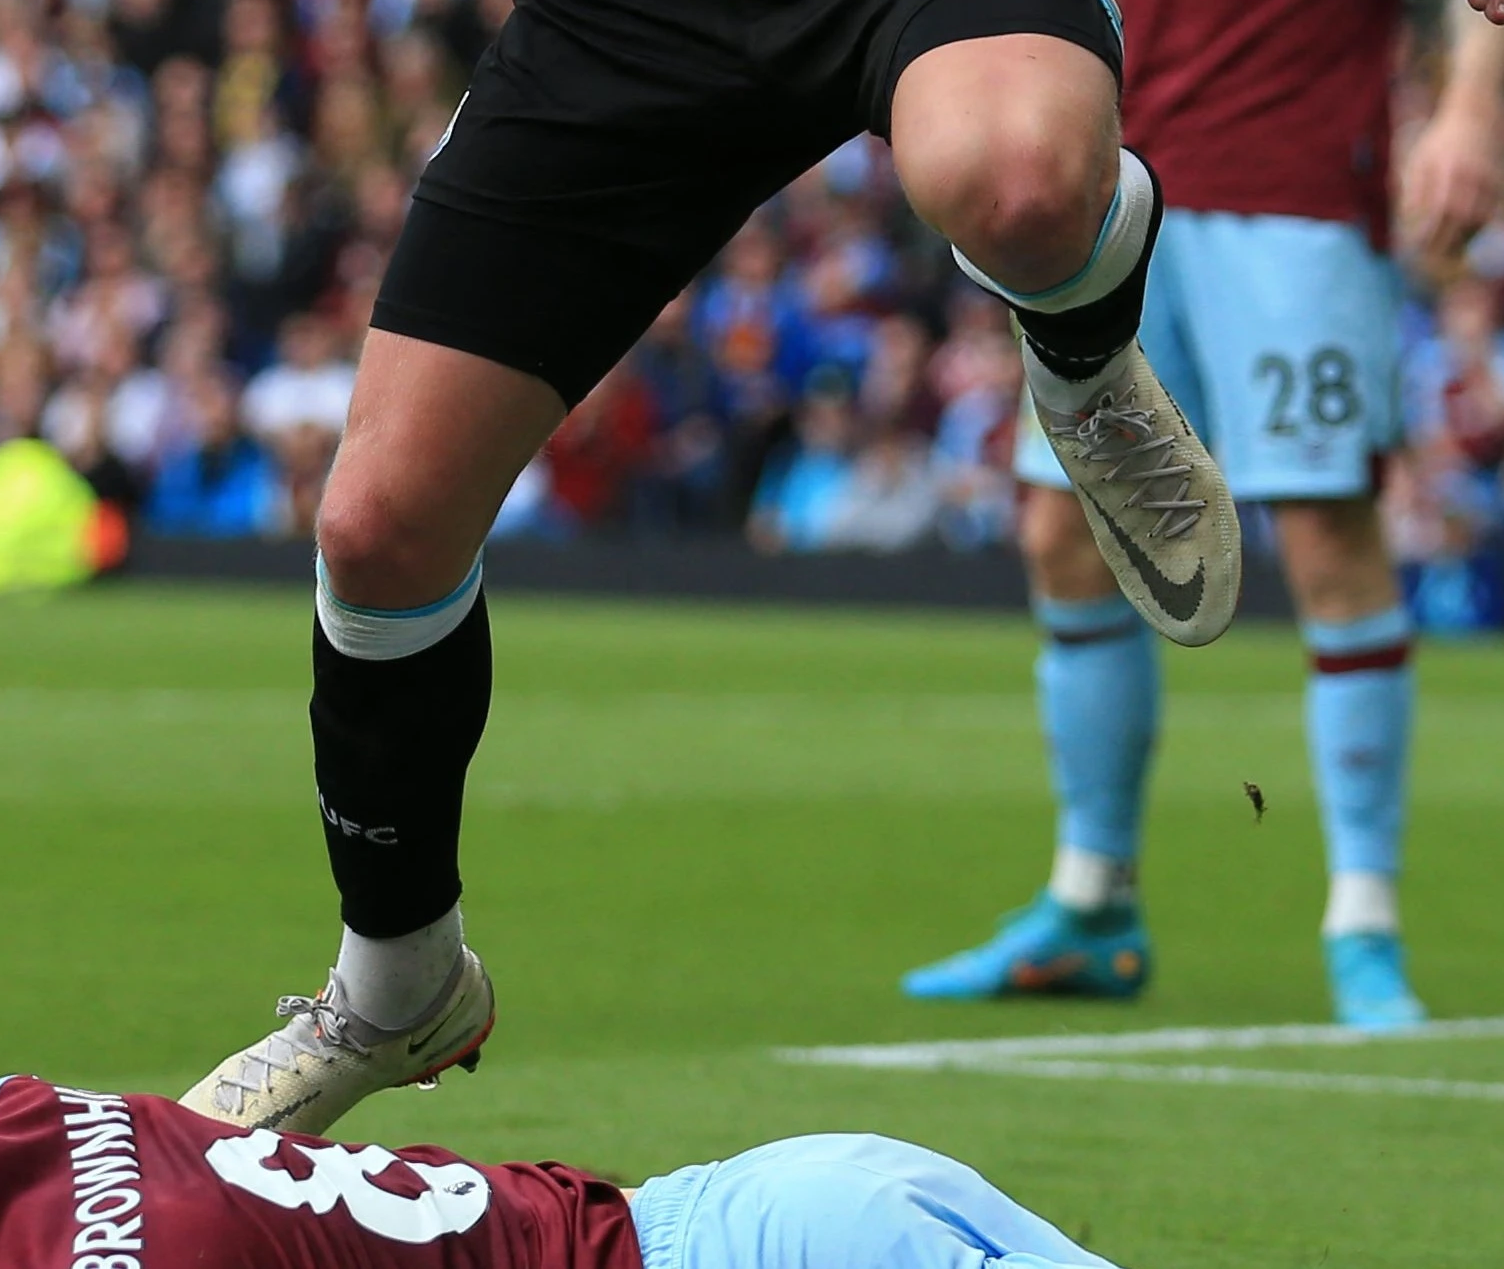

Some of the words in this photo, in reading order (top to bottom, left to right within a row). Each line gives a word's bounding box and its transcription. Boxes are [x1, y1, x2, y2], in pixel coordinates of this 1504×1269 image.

[1252, 345, 1362, 436] 28
[316, 786, 398, 844] UFC
[204, 1128, 492, 1244] 8
